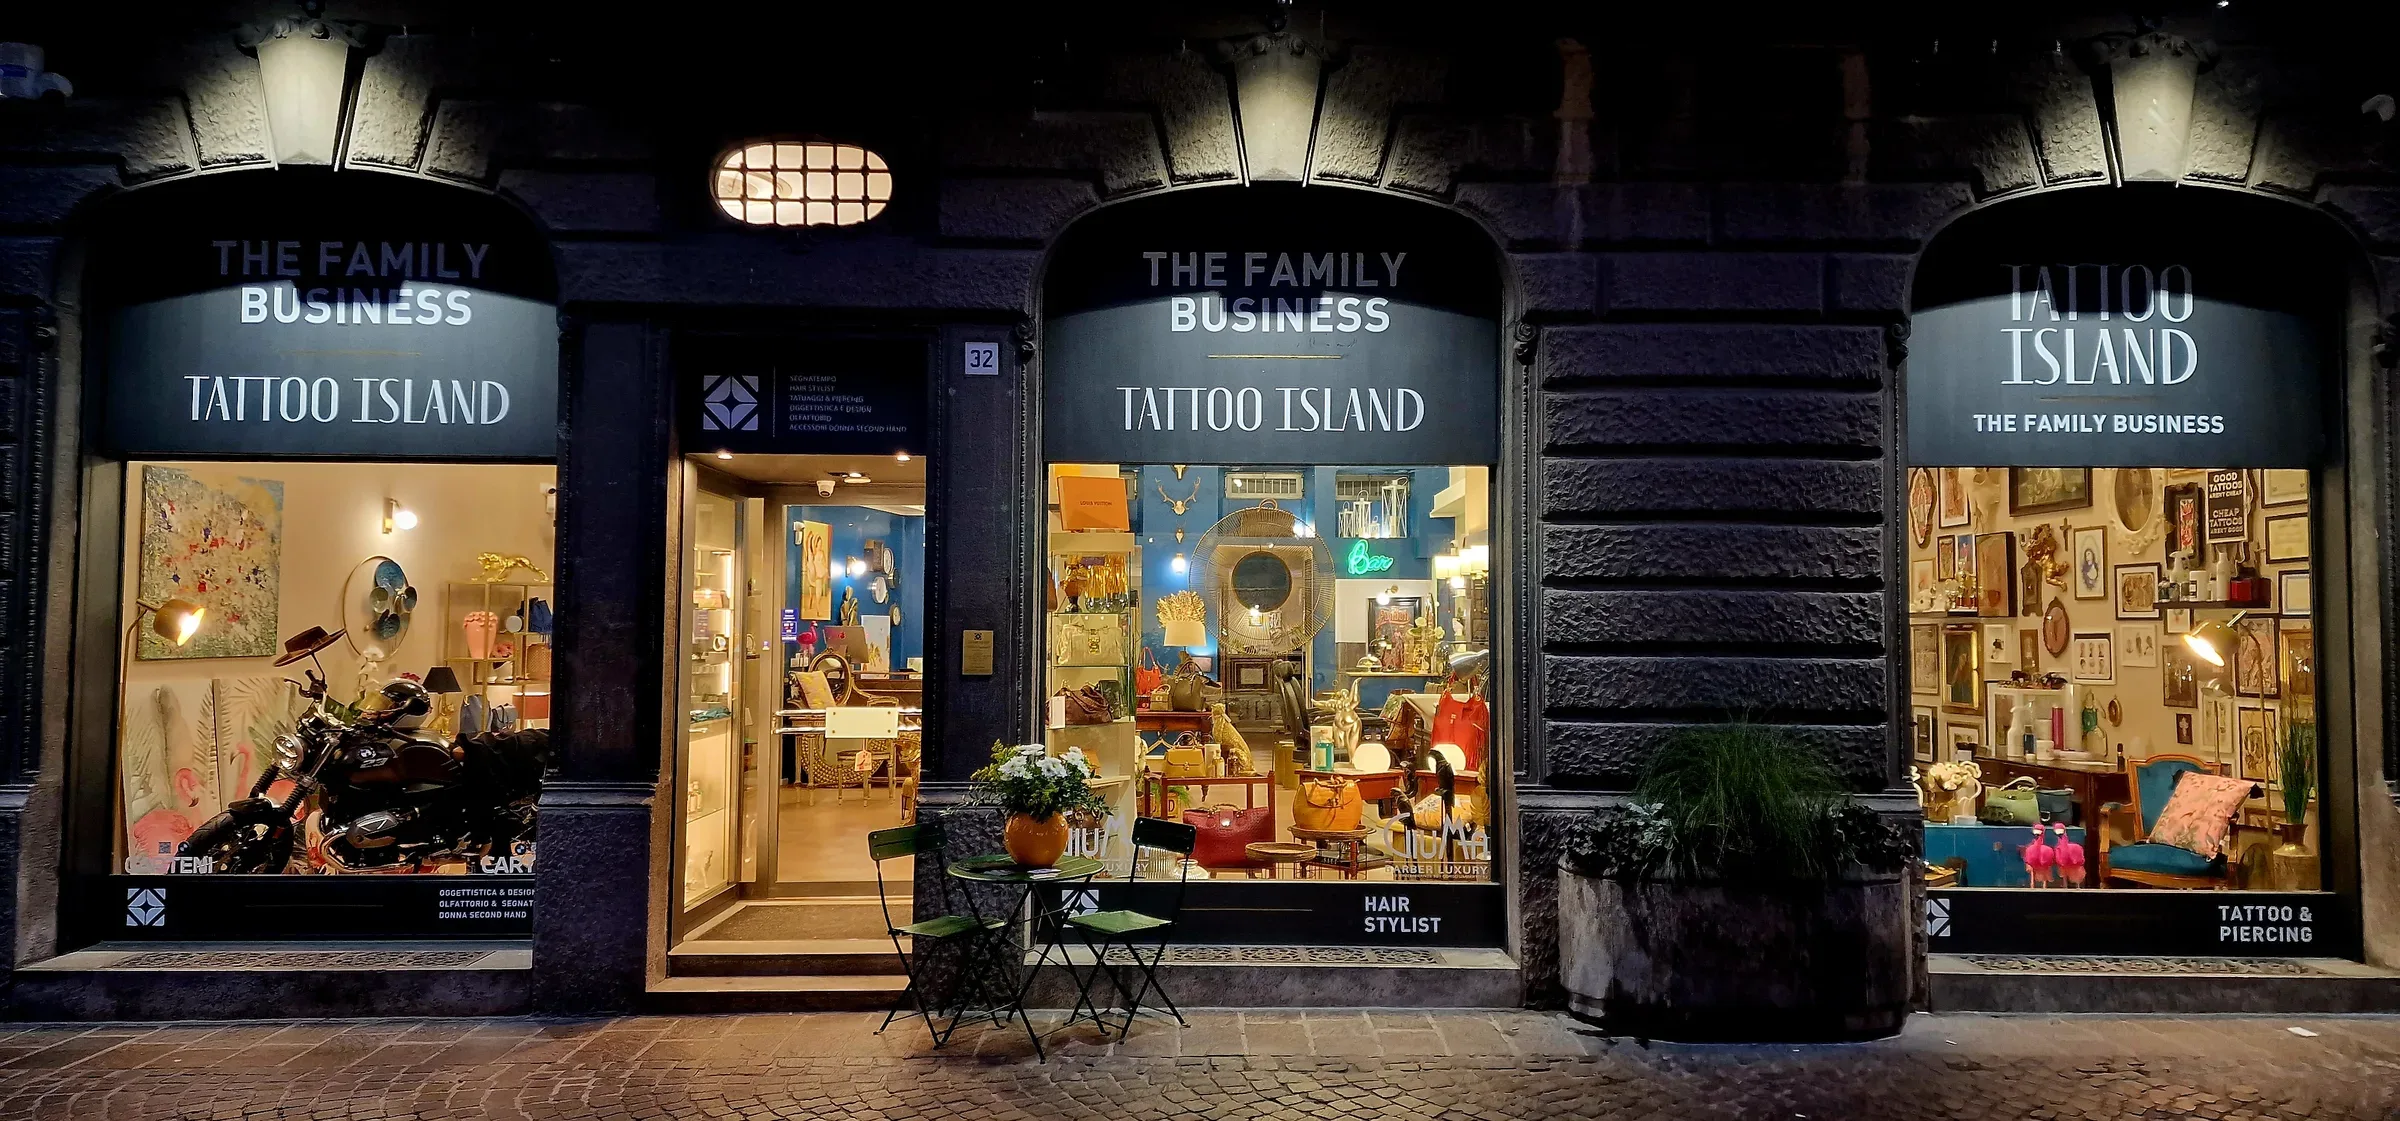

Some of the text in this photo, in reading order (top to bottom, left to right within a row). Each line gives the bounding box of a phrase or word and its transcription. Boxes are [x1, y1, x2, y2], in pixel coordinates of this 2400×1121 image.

[212, 240, 490, 280] THE FAMILY
[1142, 251, 1407, 288] THE FAMILY
[1999, 263, 2194, 323] TATTOO
[241, 286, 472, 326] BUSINESS
[1171, 296, 1391, 333] BUSINESS
[970, 348, 994, 369] 32
[2000, 327, 2199, 386] ISLAND
[184, 374, 510, 425] TATTOO ISLAND
[1116, 386, 1426, 432] TATTOO ISLAND
[1973, 413, 2225, 435] THE FAMILY BUSINESS
[2213, 472, 2237, 482] GOOD
[2209, 481, 2242, 492] TATTOOS
[2209, 517, 2242, 527] TATTOOS
[2213, 508, 2239, 518] CHEAP
[1347, 539, 1394, 575] Bar
[1384, 864, 1489, 875] BARBER LUXURY
[439, 889, 497, 897] OGGETTISTICA
[439, 900, 489, 908] OLFATTORIO
[1364, 896, 1410, 912] HAIR
[439, 911, 527, 919] DONNA SECOND HAND
[2218, 905, 2313, 922] TATTOO &
[1364, 916, 1442, 933] STYLIST
[2219, 925, 2313, 943] PIERCING
